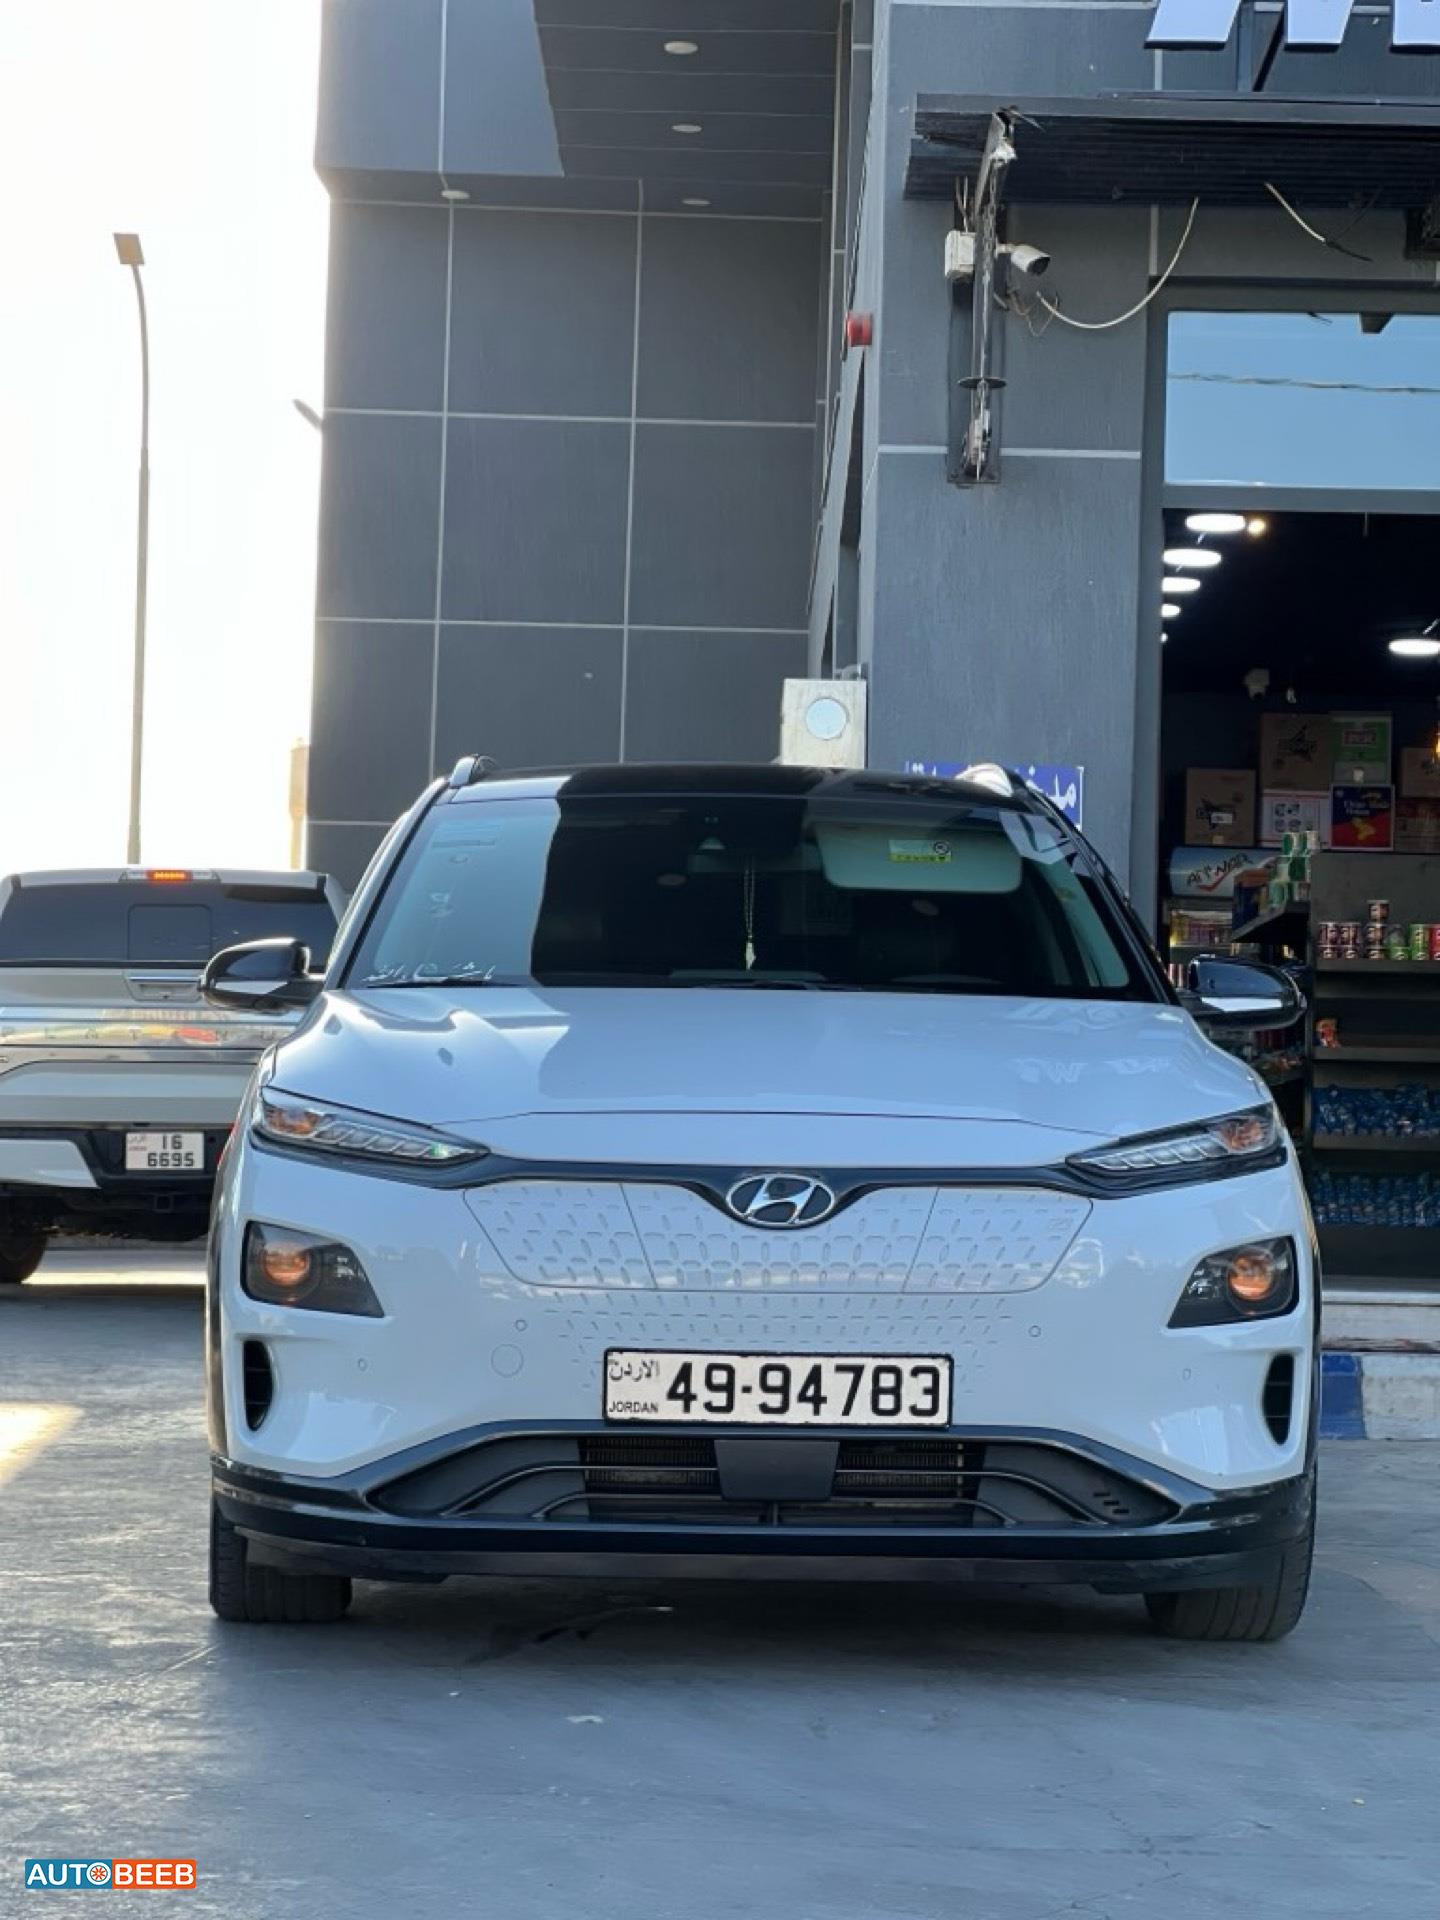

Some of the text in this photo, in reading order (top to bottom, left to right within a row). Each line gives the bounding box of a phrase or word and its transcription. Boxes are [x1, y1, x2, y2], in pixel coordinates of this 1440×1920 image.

[162, 1135, 183, 1150] 16
[147, 1152, 195, 1167] 6695
[666, 1361, 941, 1417] 49-94783
[608, 1400, 659, 1413] JORDAN
